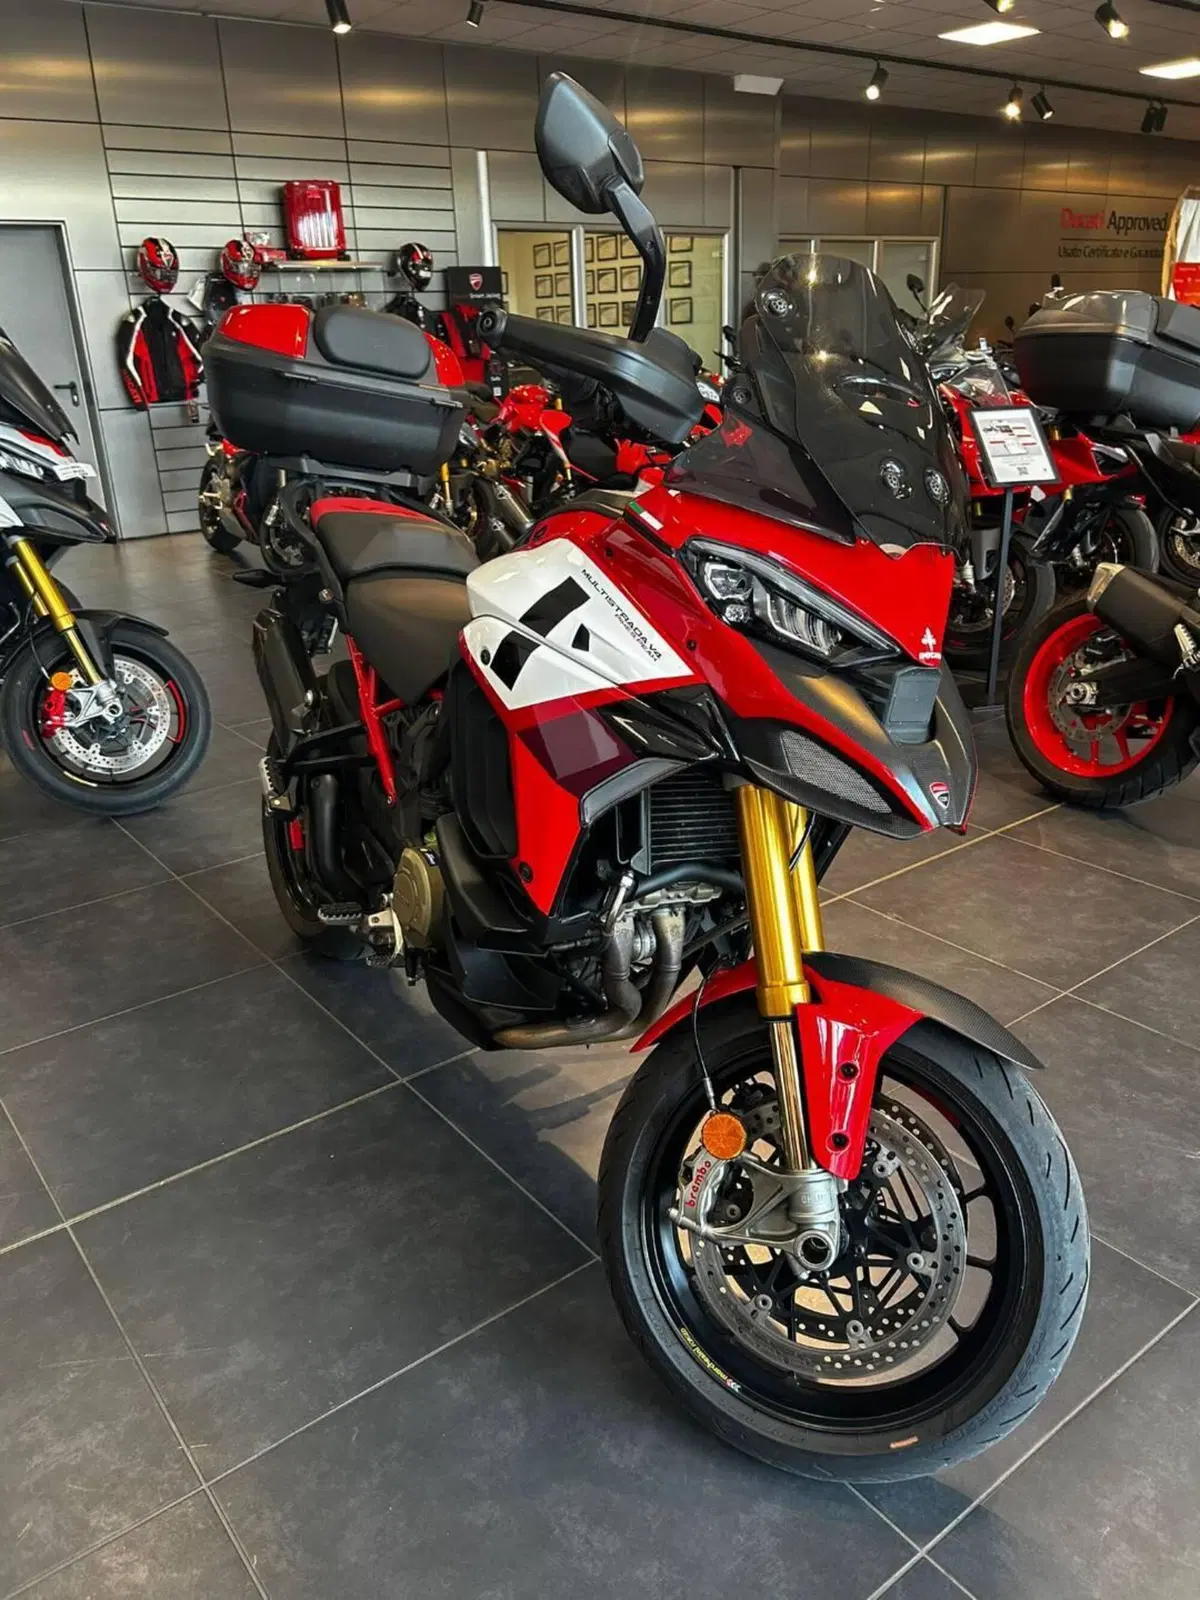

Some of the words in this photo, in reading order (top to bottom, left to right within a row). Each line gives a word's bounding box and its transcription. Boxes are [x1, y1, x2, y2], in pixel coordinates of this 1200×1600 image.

[1060, 207, 1105, 231] Ducati
[1106, 210, 1168, 235] Approved
[581, 569, 648, 644] MULTISTRADA
[649, 643, 662, 660] V4
[684, 1160, 712, 1208] brembo
[692, 1346, 728, 1380] marchesini
